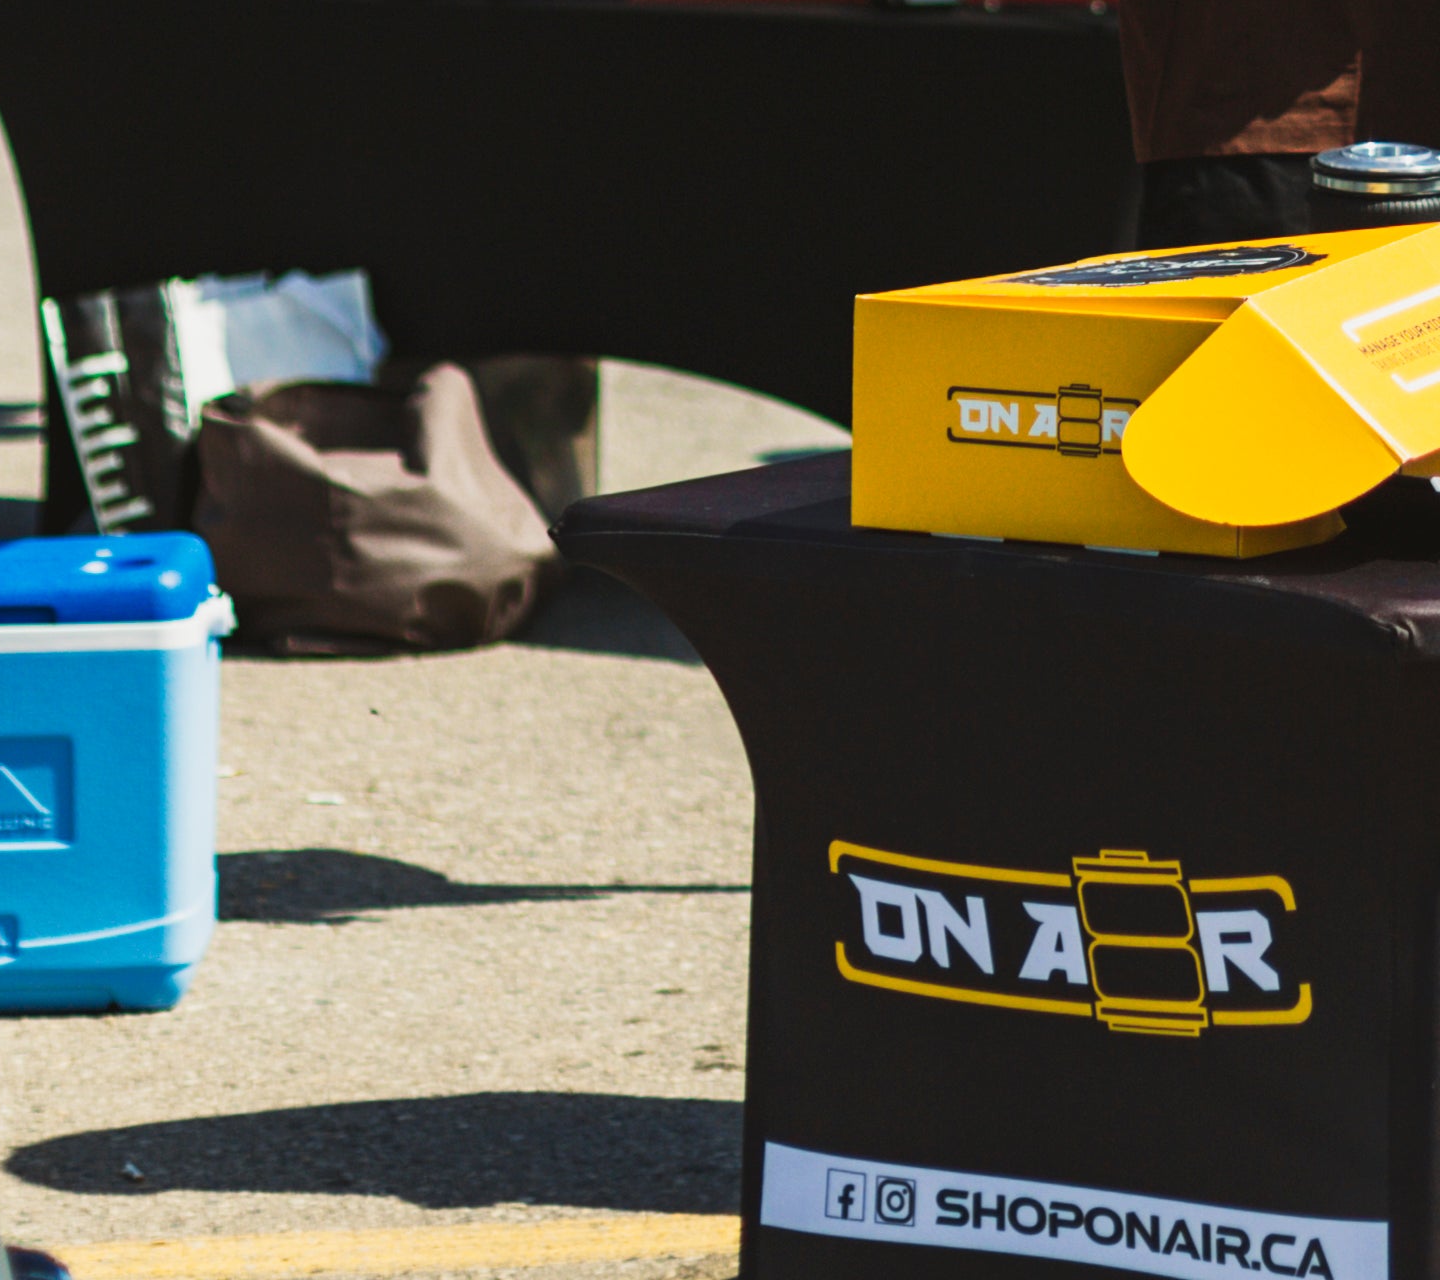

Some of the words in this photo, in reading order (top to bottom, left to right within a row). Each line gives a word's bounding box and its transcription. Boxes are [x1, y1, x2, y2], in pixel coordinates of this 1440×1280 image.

[956, 397, 1020, 436] ON
[848, 872, 995, 976] ON
[935, 1187, 1334, 1278] SHOPONAIR.CA
